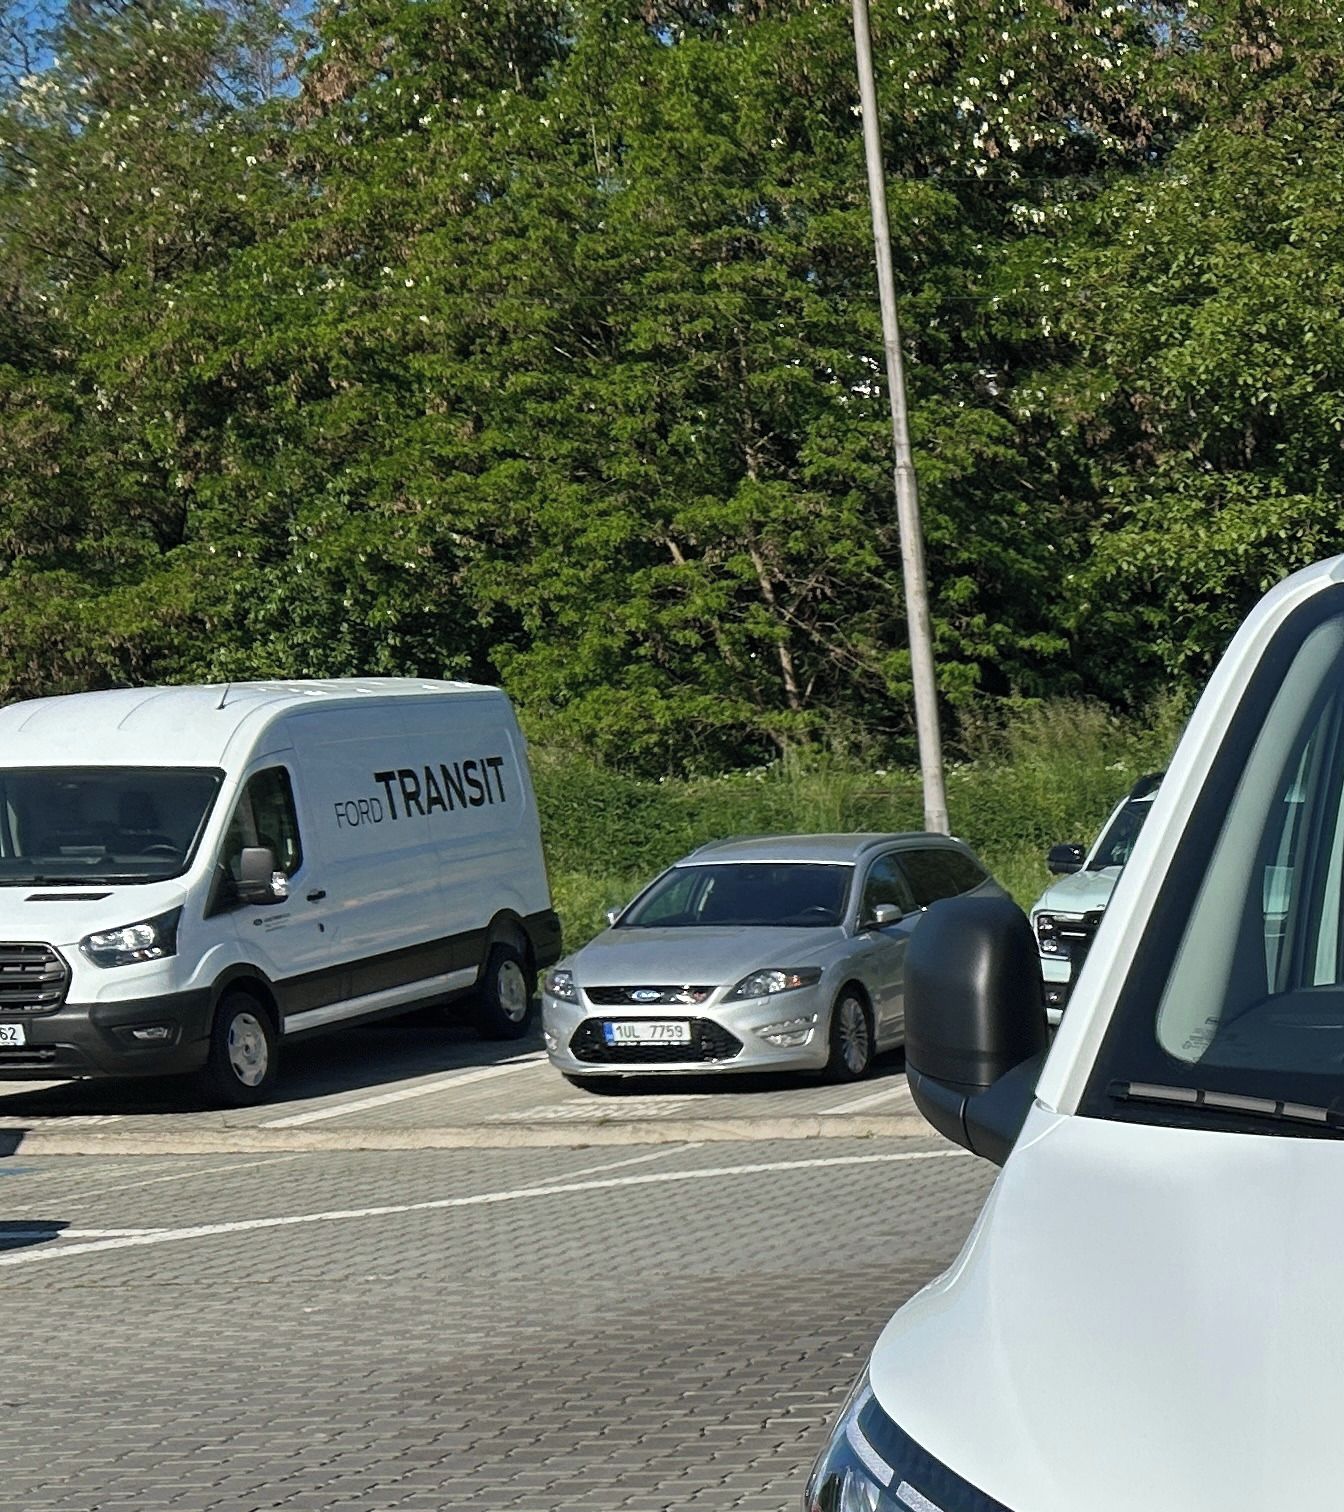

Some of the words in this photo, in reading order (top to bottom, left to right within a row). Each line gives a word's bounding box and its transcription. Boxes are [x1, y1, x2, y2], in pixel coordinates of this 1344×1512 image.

[334, 798, 383, 828] FORD
[373, 757, 506, 820] TRANSIT
[649, 1025, 683, 1038] 7759
